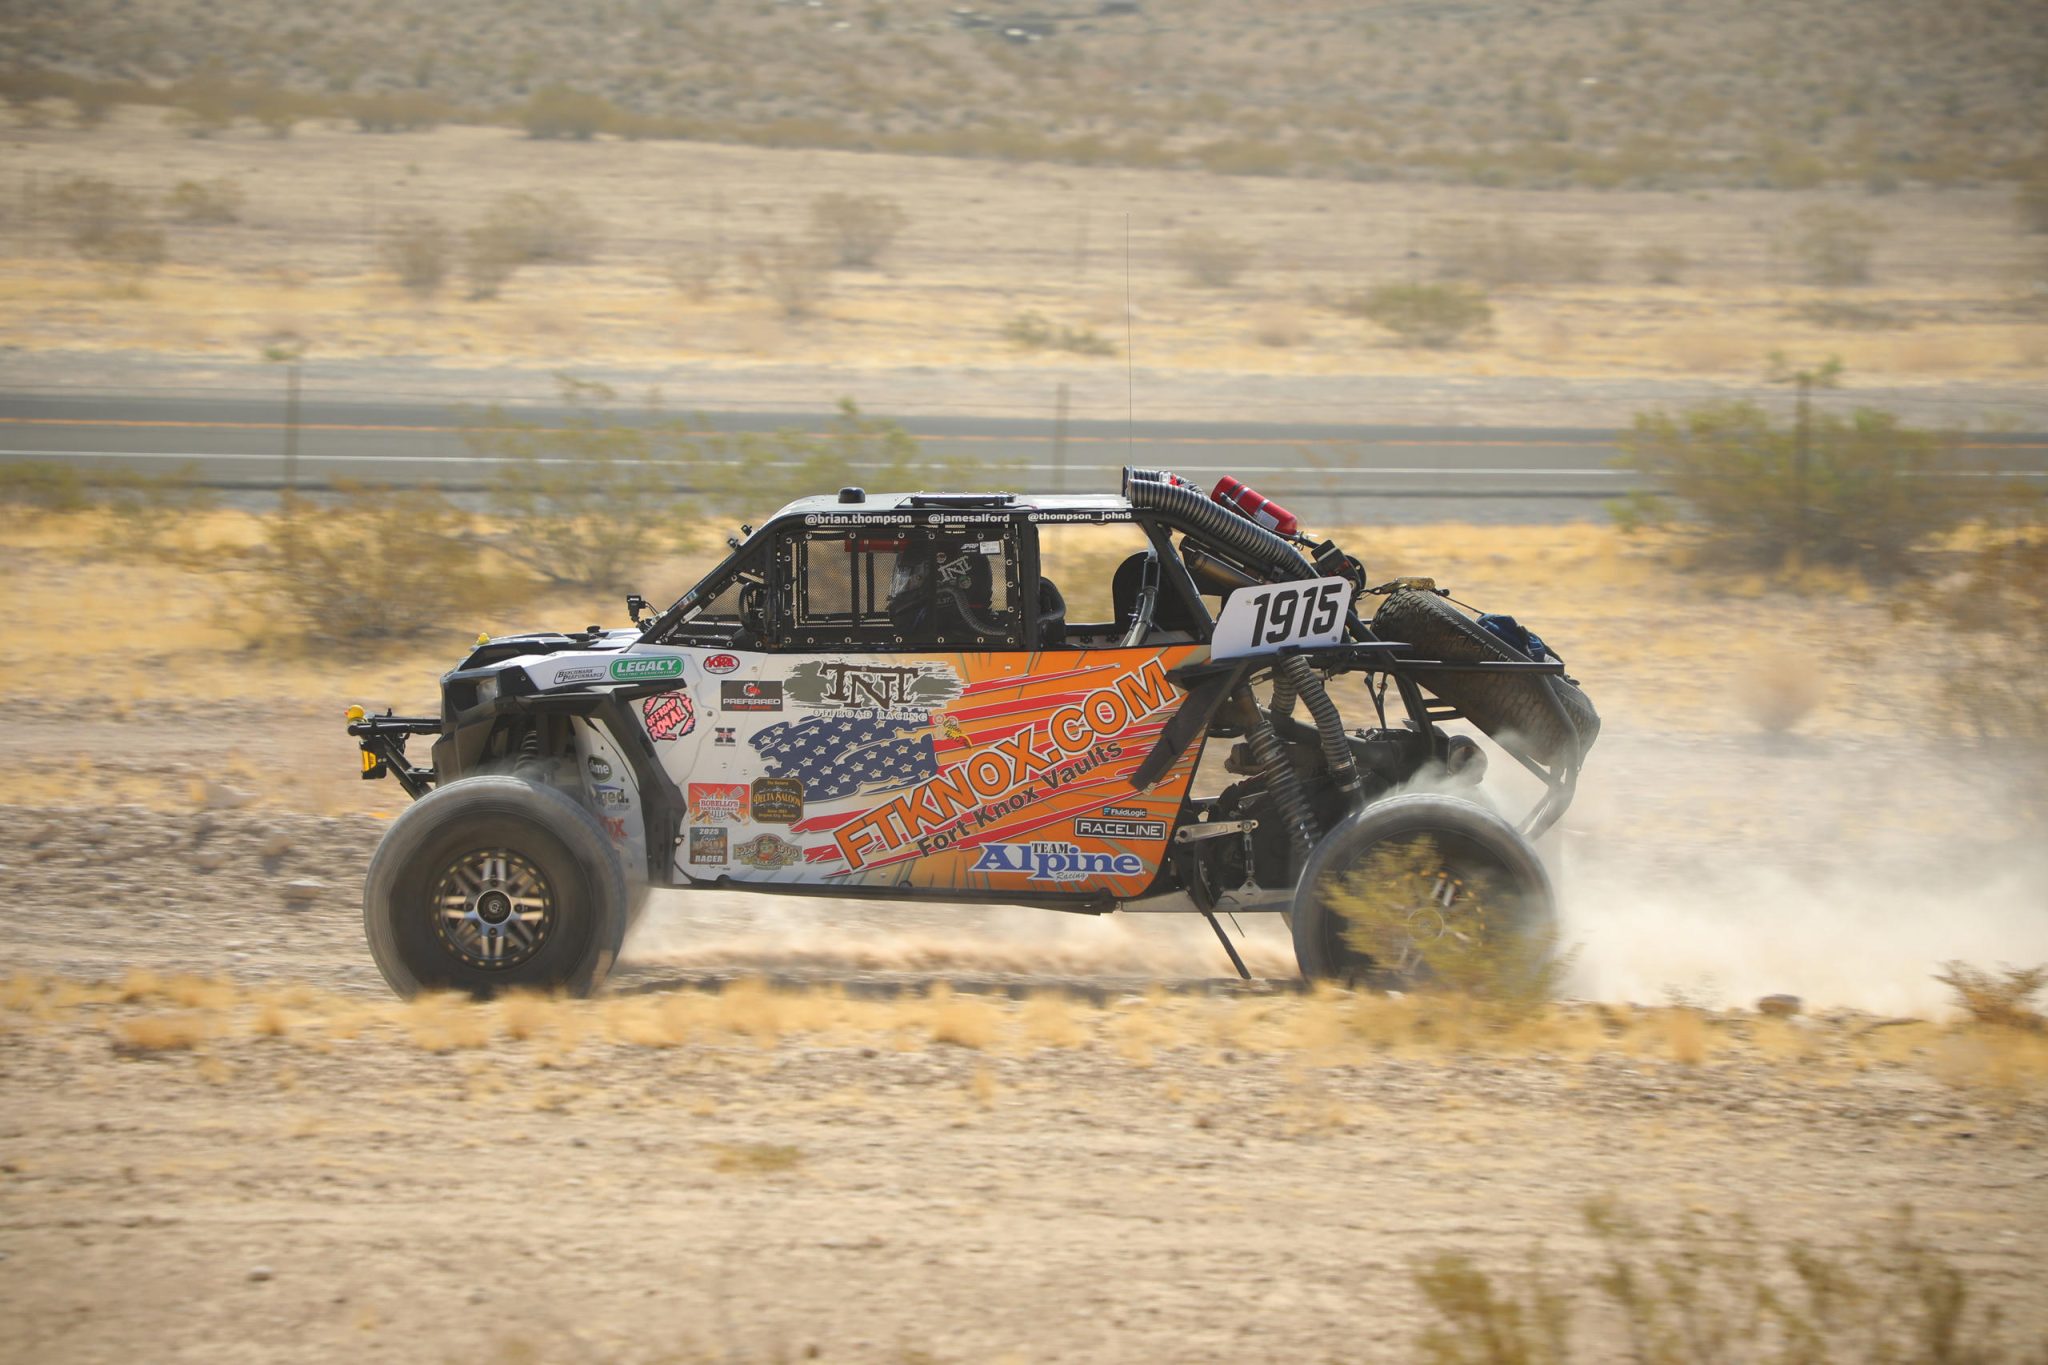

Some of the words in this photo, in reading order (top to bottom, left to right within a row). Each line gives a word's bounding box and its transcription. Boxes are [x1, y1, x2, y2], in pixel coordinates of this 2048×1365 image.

[804, 513, 912, 526] @brian.thompson
[928, 512, 1010, 524] @jamesalford
[1251, 583, 1343, 647] 1915
[616, 659, 679, 673] LEGACY
[812, 708, 873, 719] OFFROAD
[877, 710, 928, 721] RACING
[834, 657, 1180, 870] FTKNOX.COM
[917, 820, 970, 857] Fort
[974, 788, 1039, 828] Knox
[1040, 740, 1124, 790] Vaults
[1111, 807, 1146, 817] FluidLogic
[1080, 822, 1160, 836] RACELINE
[1031, 843, 1069, 854] TEAM
[974, 844, 1141, 879] Alpine
[1055, 871, 1087, 881] Racing
